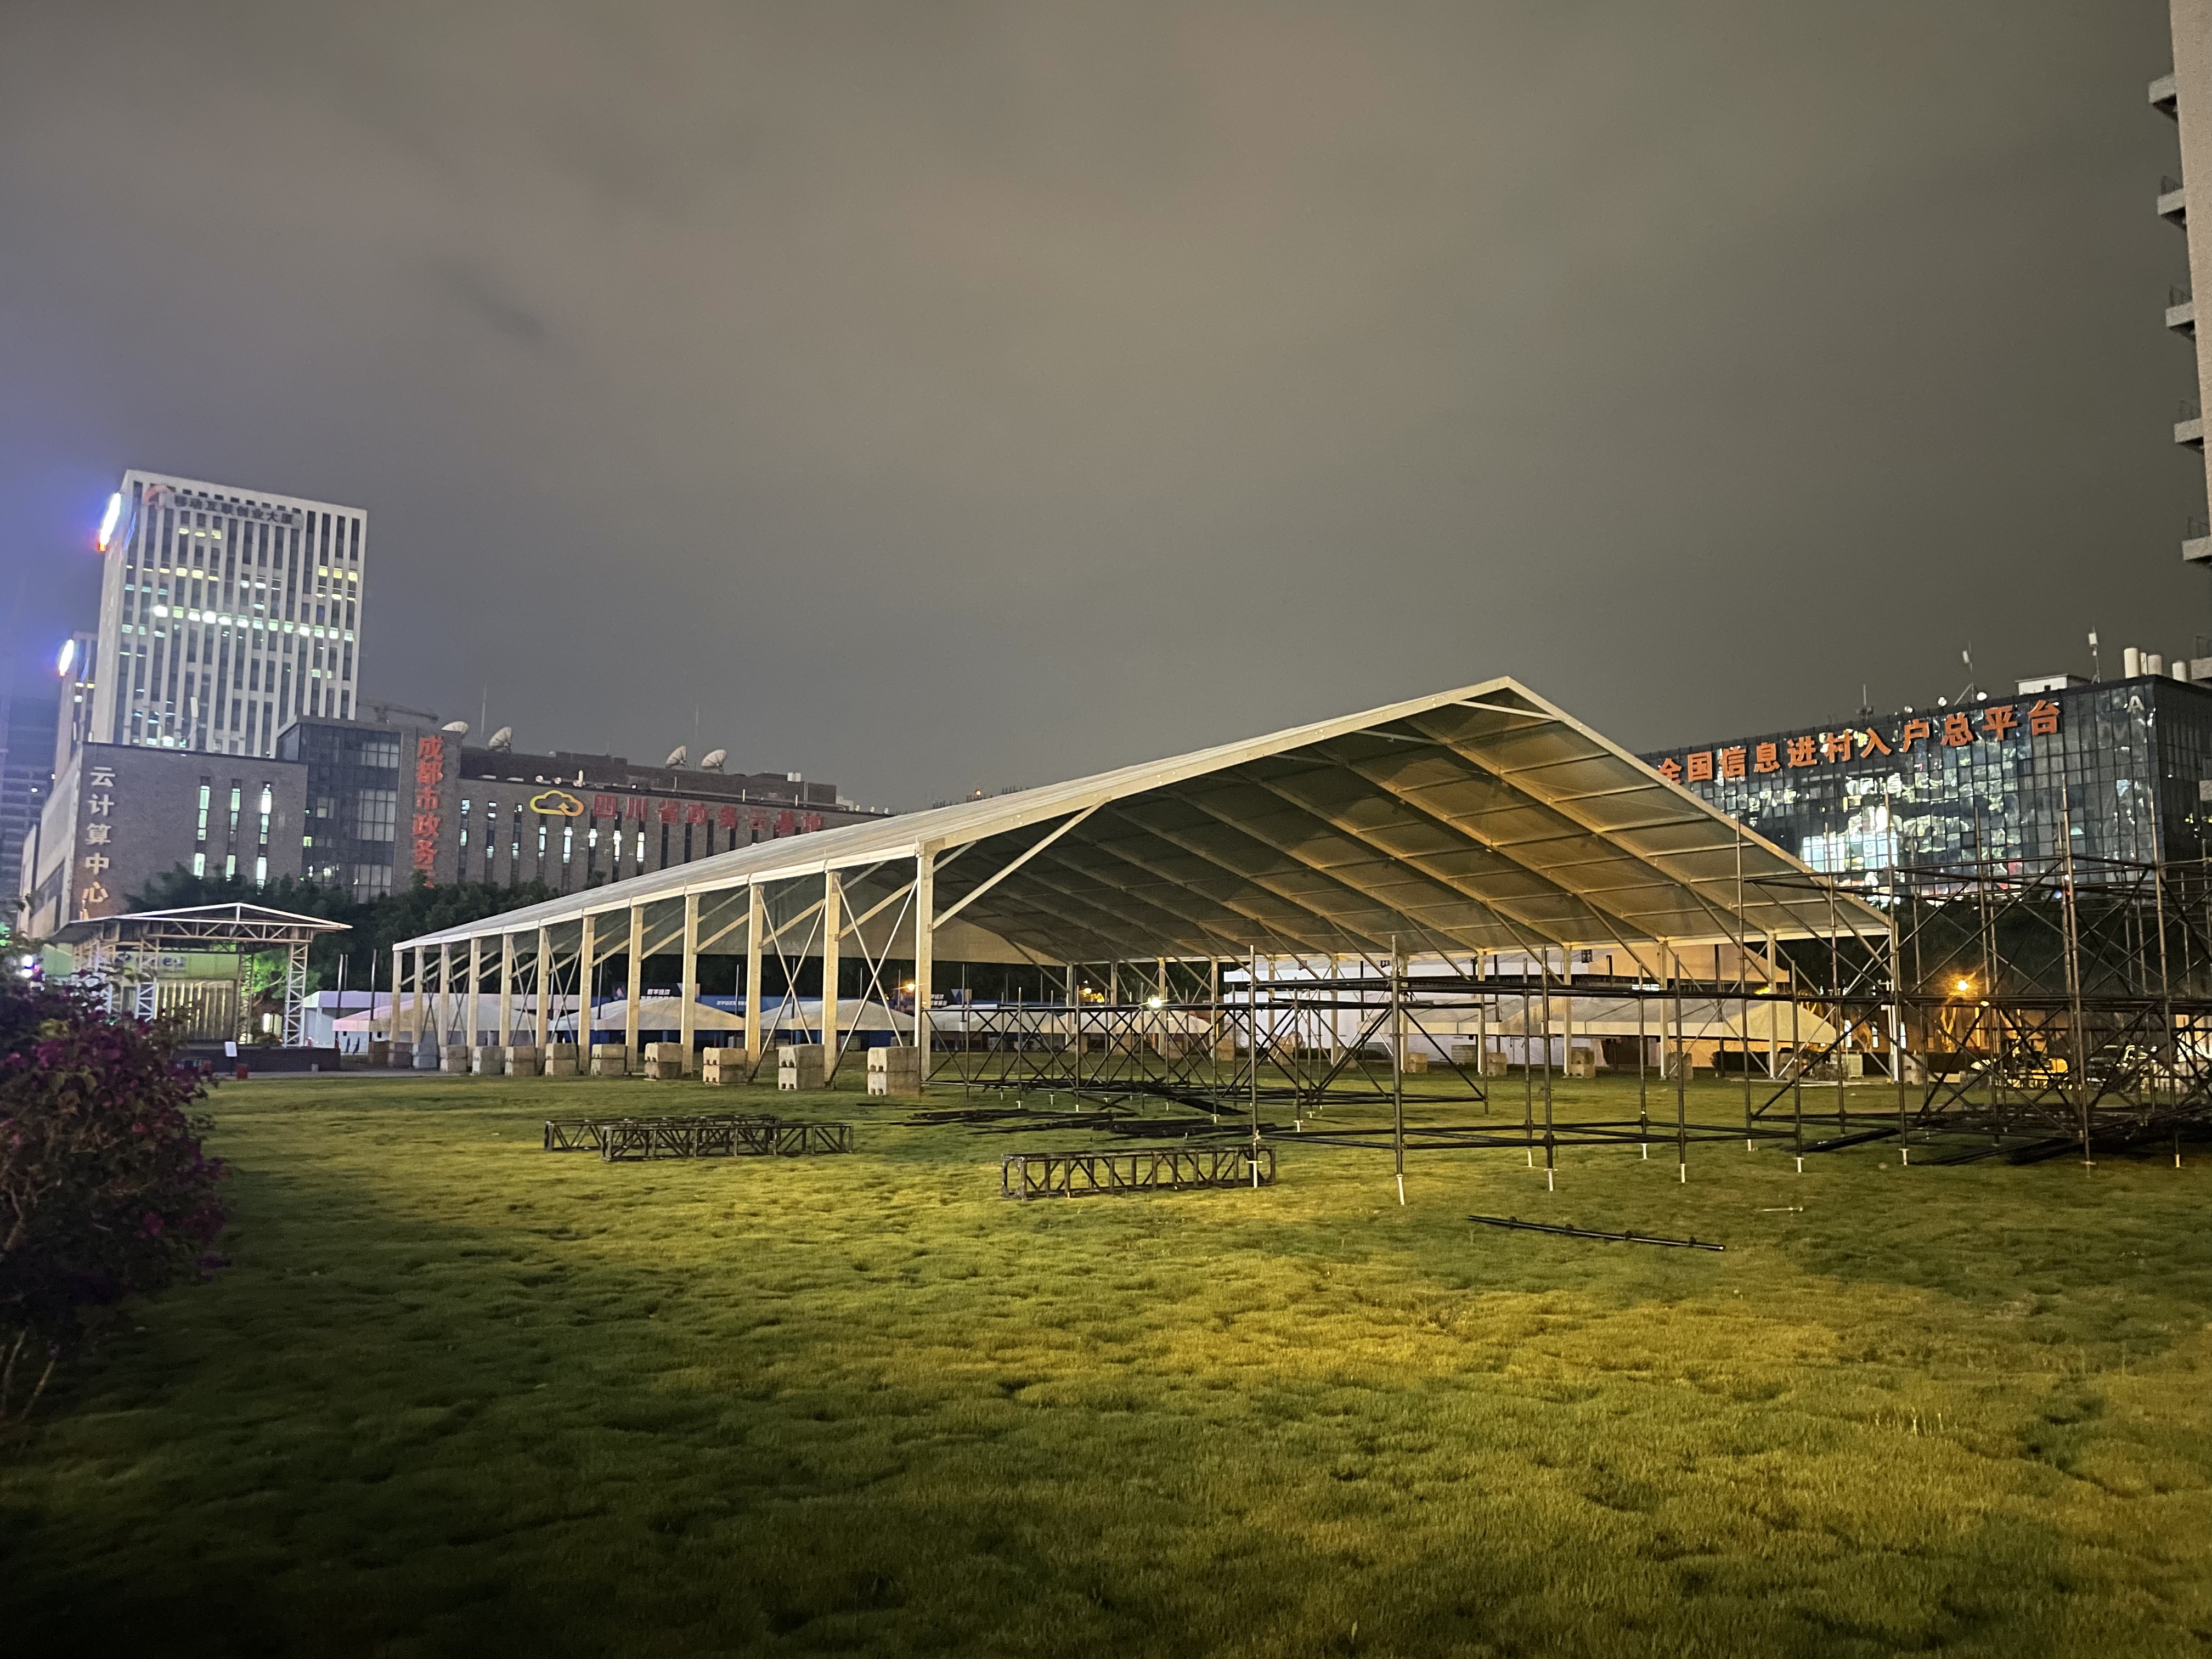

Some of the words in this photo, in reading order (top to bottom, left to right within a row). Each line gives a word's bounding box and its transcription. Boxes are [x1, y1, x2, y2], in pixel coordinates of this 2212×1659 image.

[2126, 695, 2145, 713] A
[1658, 699, 2060, 785] 全国信息进村入户总平台
[83, 766, 116, 903] 云计算中心
[594, 794, 822, 833] 四川省政务云基地
